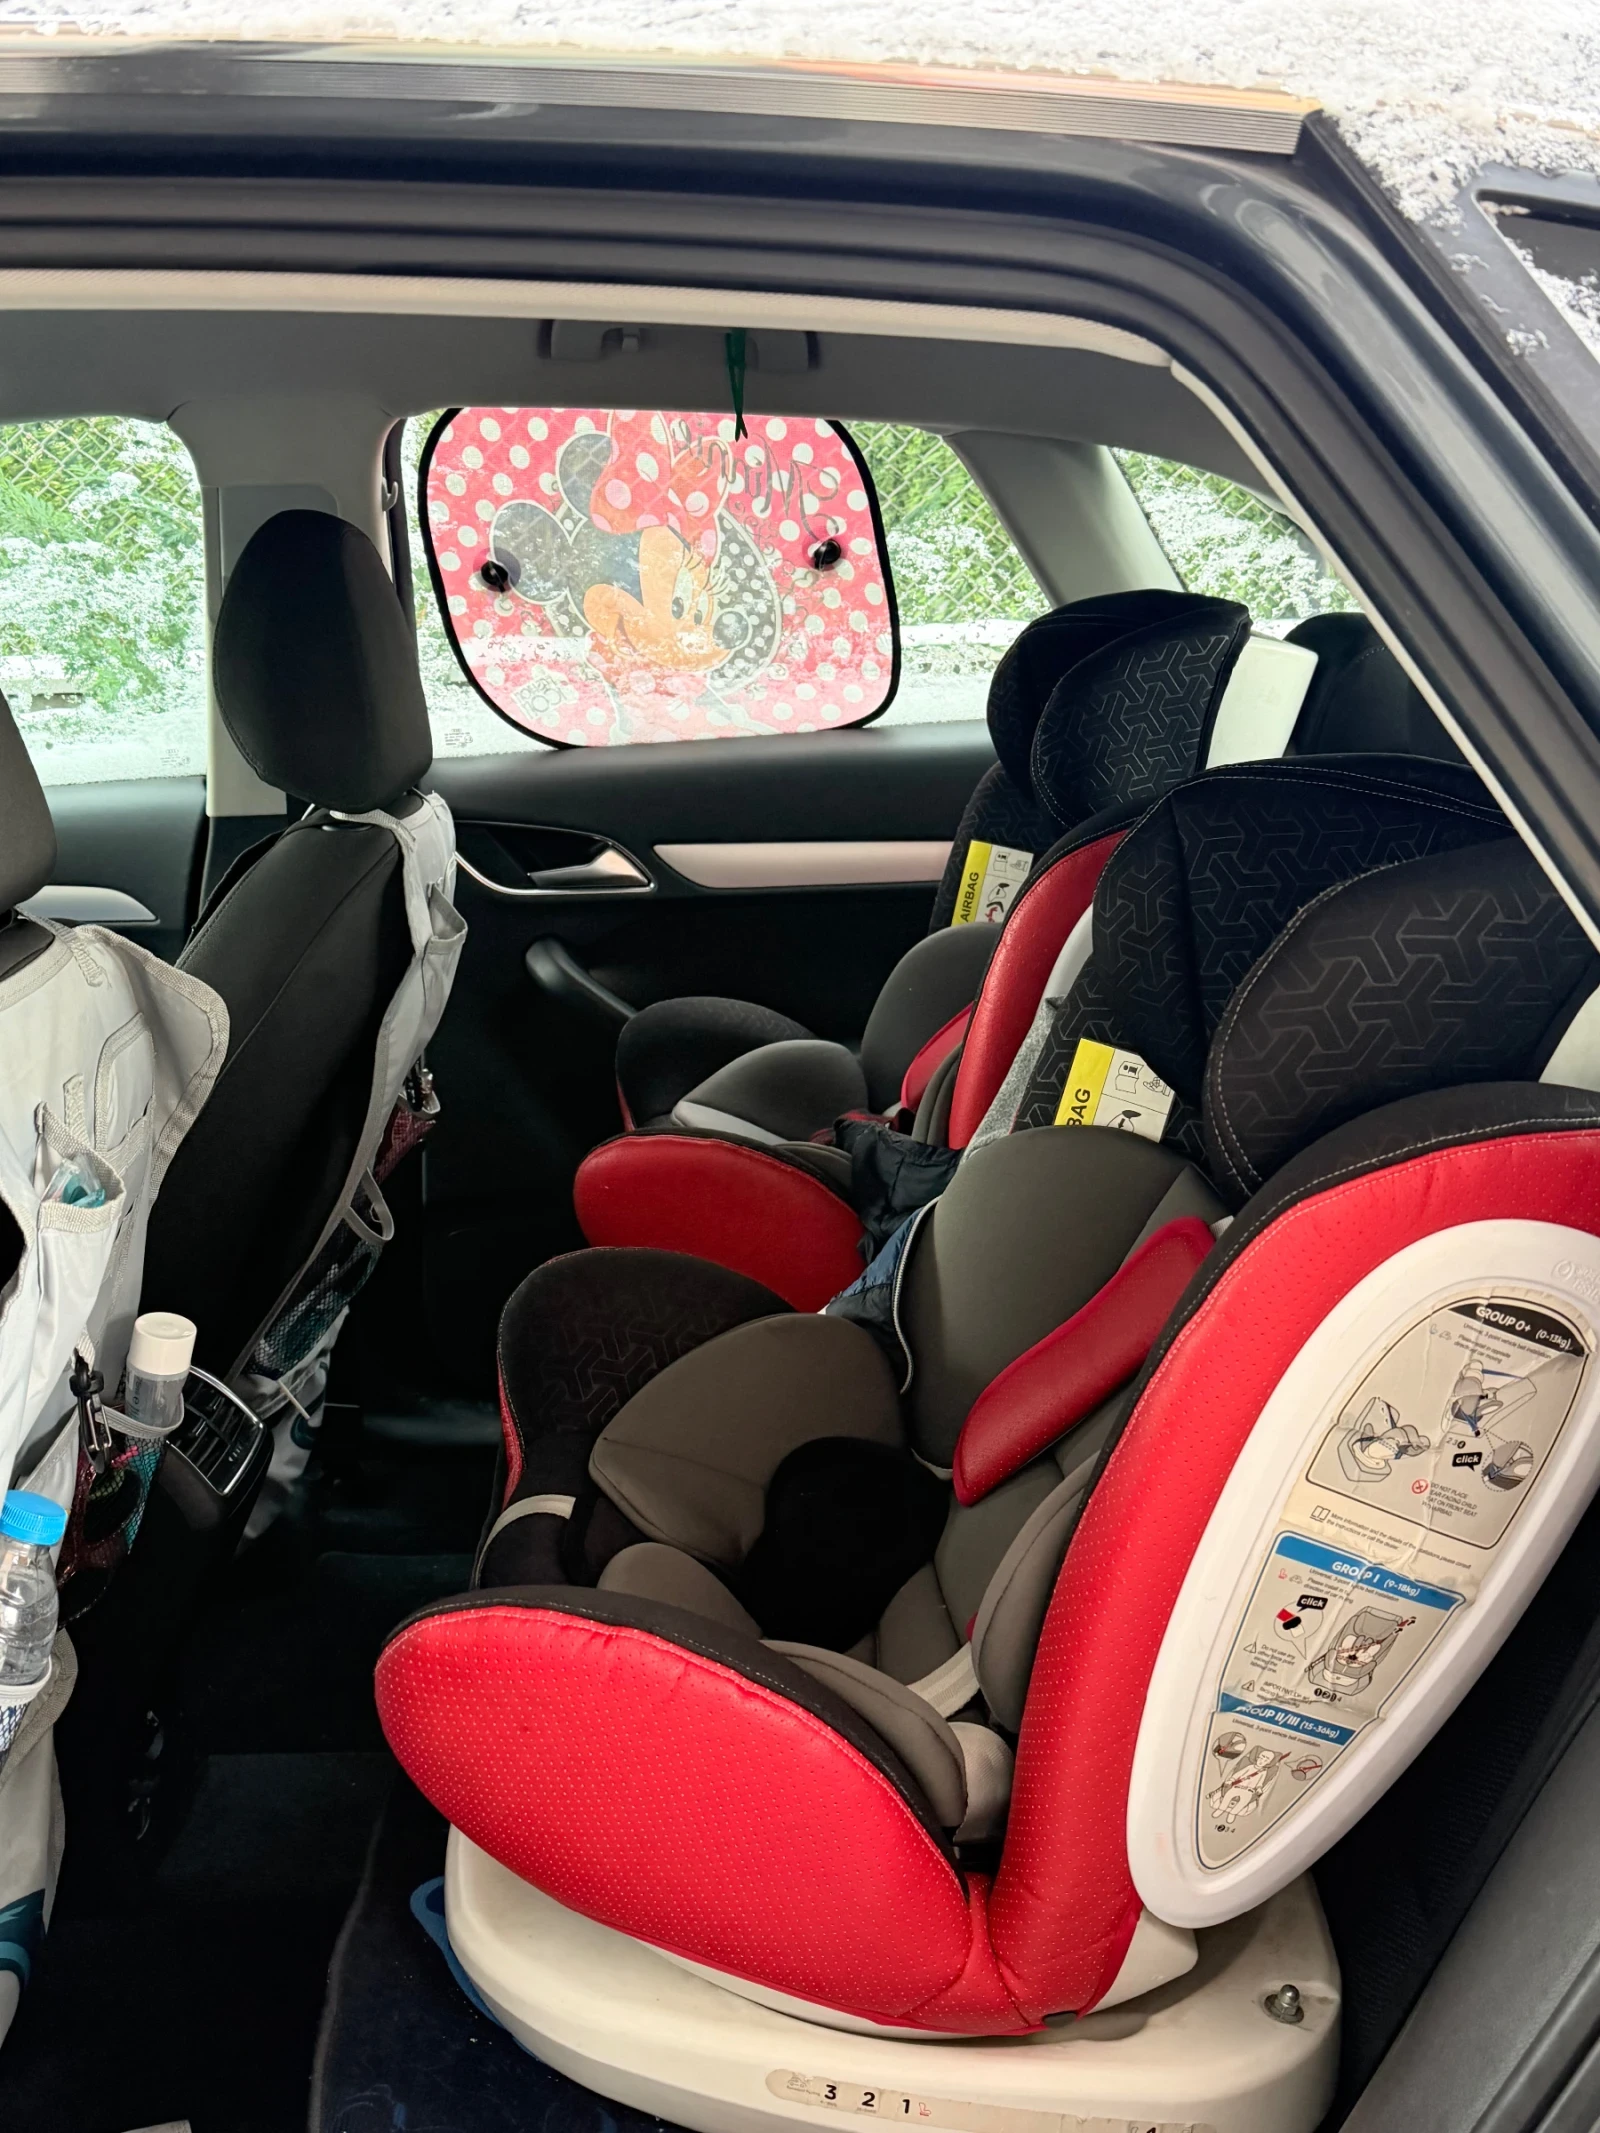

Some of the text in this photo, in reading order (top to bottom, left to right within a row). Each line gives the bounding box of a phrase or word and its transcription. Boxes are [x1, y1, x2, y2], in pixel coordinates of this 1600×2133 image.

[960, 872, 979, 922] AIRBAG
[1067, 1088, 1091, 1126] BAG
[1476, 1306, 1572, 1350] GROUP 0+ (0-13kg)
[1455, 1454, 1479, 1464] click
[1440, 1485, 1451, 1494] NOT
[1330, 1512, 1343, 1522] More
[1343, 1516, 1369, 1530] information
[1373, 1574, 1380, 1583] I
[1384, 1579, 1420, 1597] (9-18kg)
[1300, 1597, 1324, 1608] click
[1300, 1721, 1340, 1738] (15-36kg)
[824, 2084, 837, 2100] 3
[862, 2092, 875, 2107] 2
[902, 2099, 910, 2113] 1
